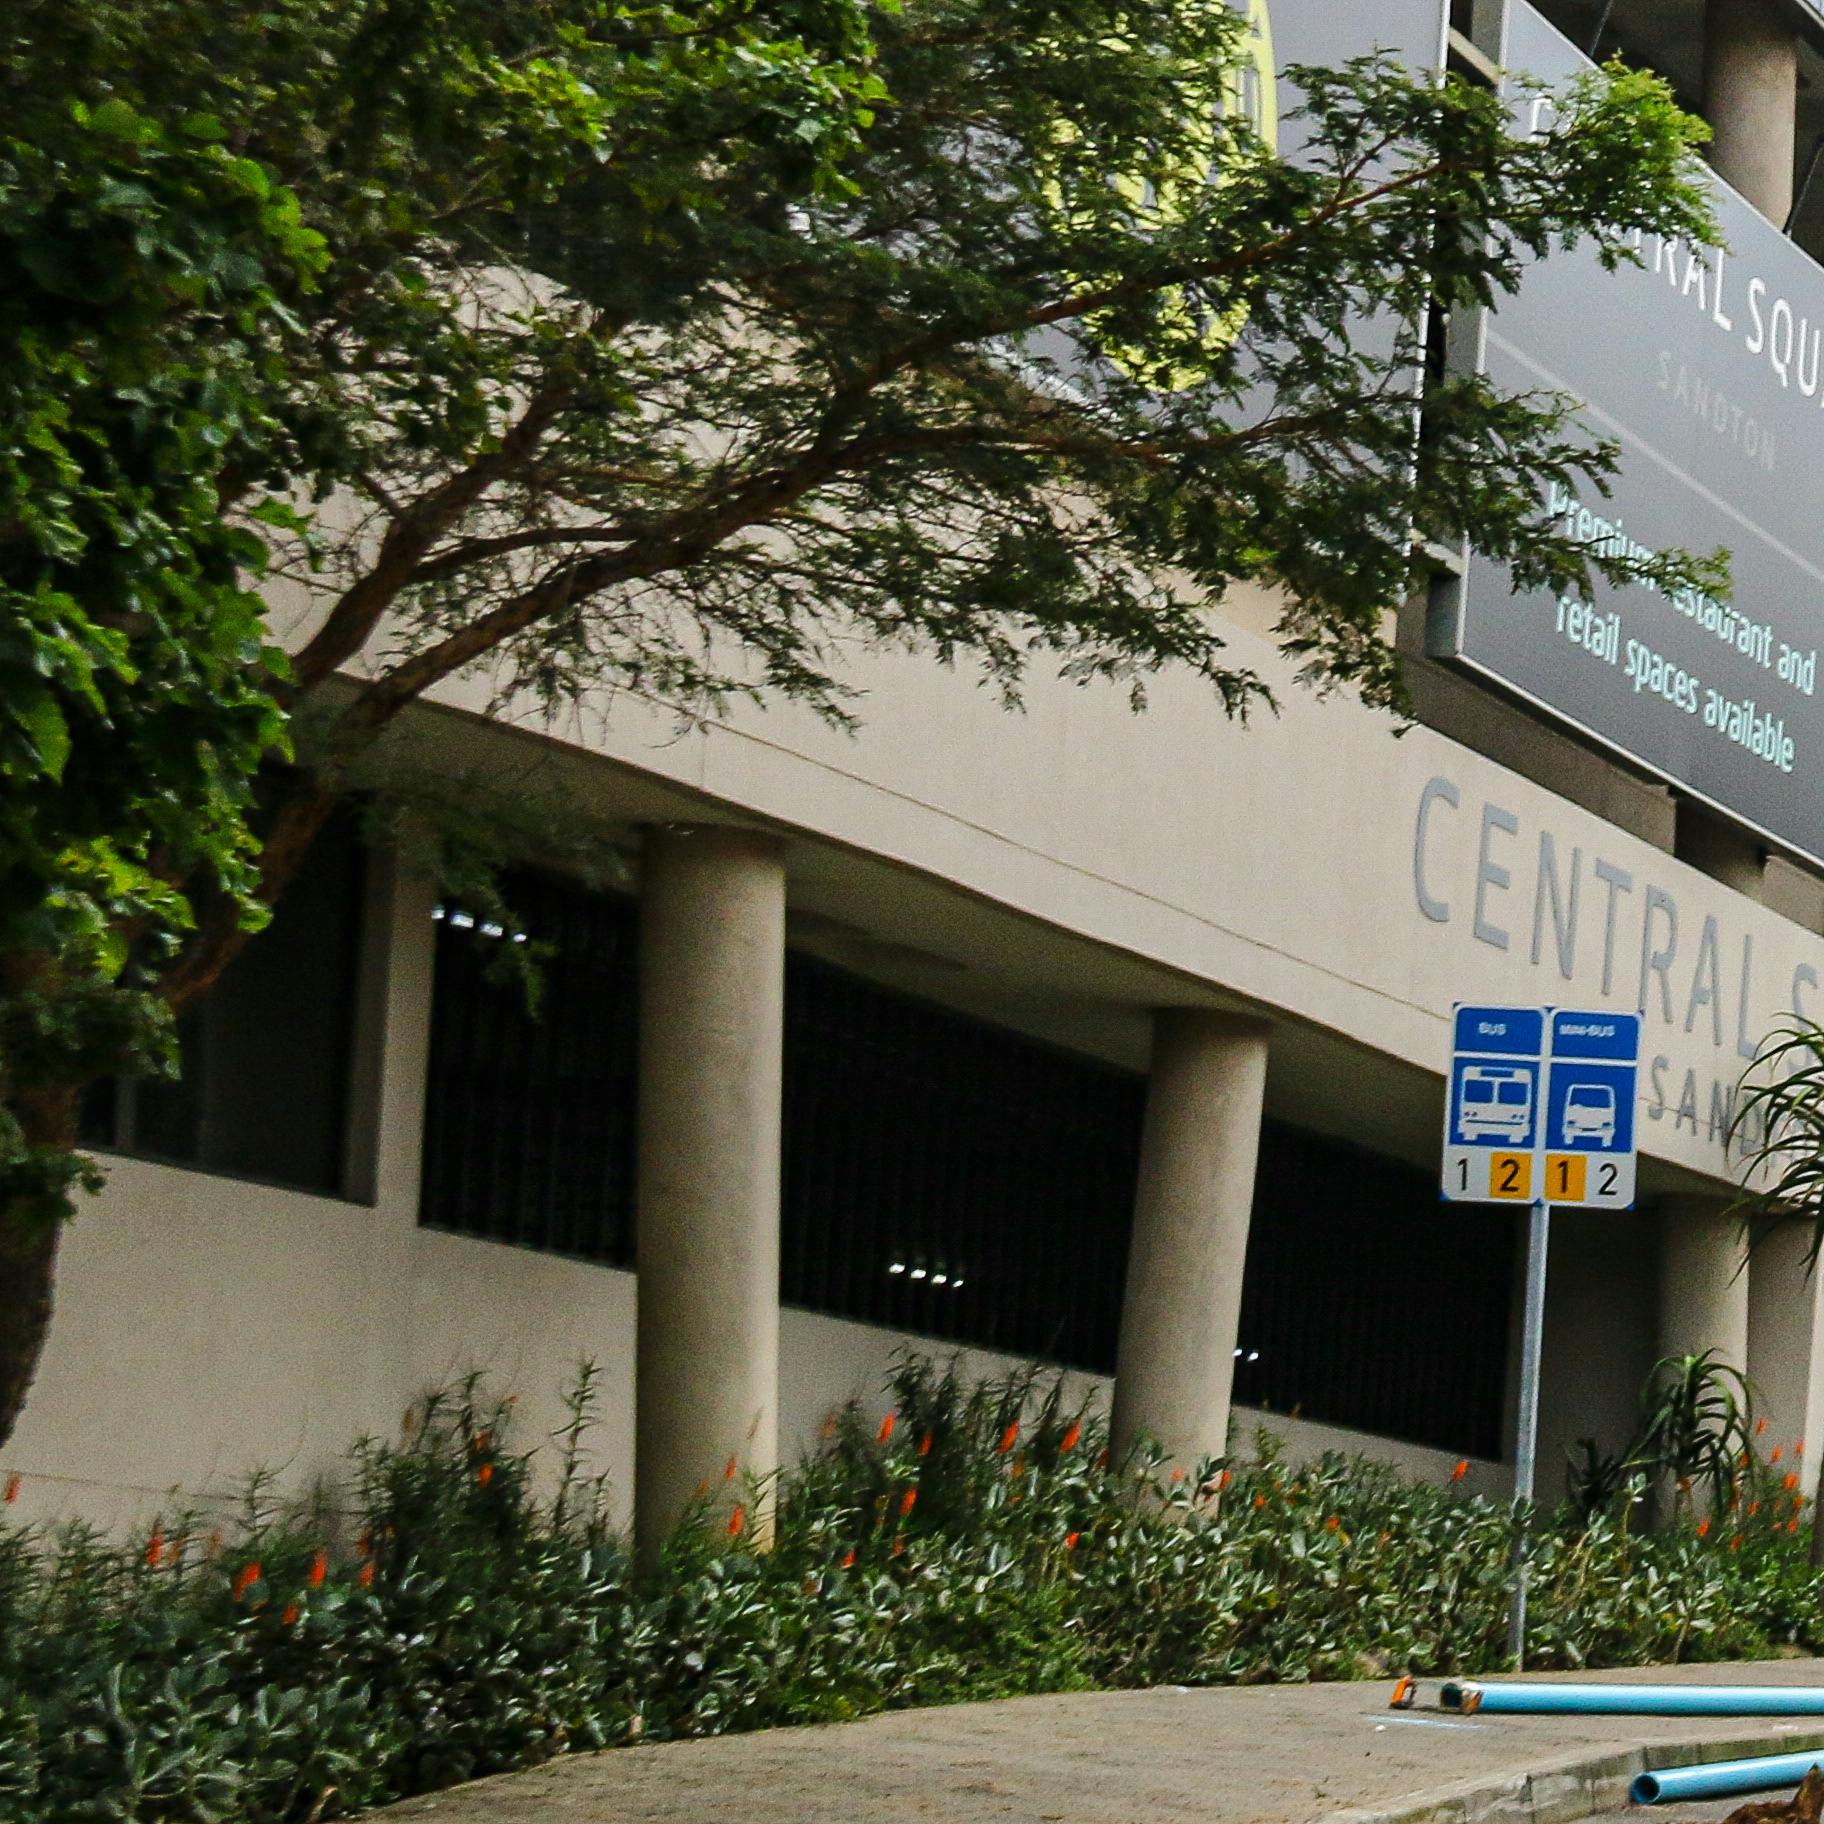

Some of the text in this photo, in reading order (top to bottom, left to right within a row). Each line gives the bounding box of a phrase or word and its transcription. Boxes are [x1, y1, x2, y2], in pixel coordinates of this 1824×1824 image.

[1657, 350, 1777, 472] SANDTON
[1555, 596, 1796, 774] retail spaces available
[1777, 642, 1817, 696] and
[1412, 775, 1758, 1059] CENTRAL
[1478, 1021, 1508, 1036] BUS
[1457, 1157, 1520, 1192] 1 2
[1558, 1160, 1618, 1196] 1 2
